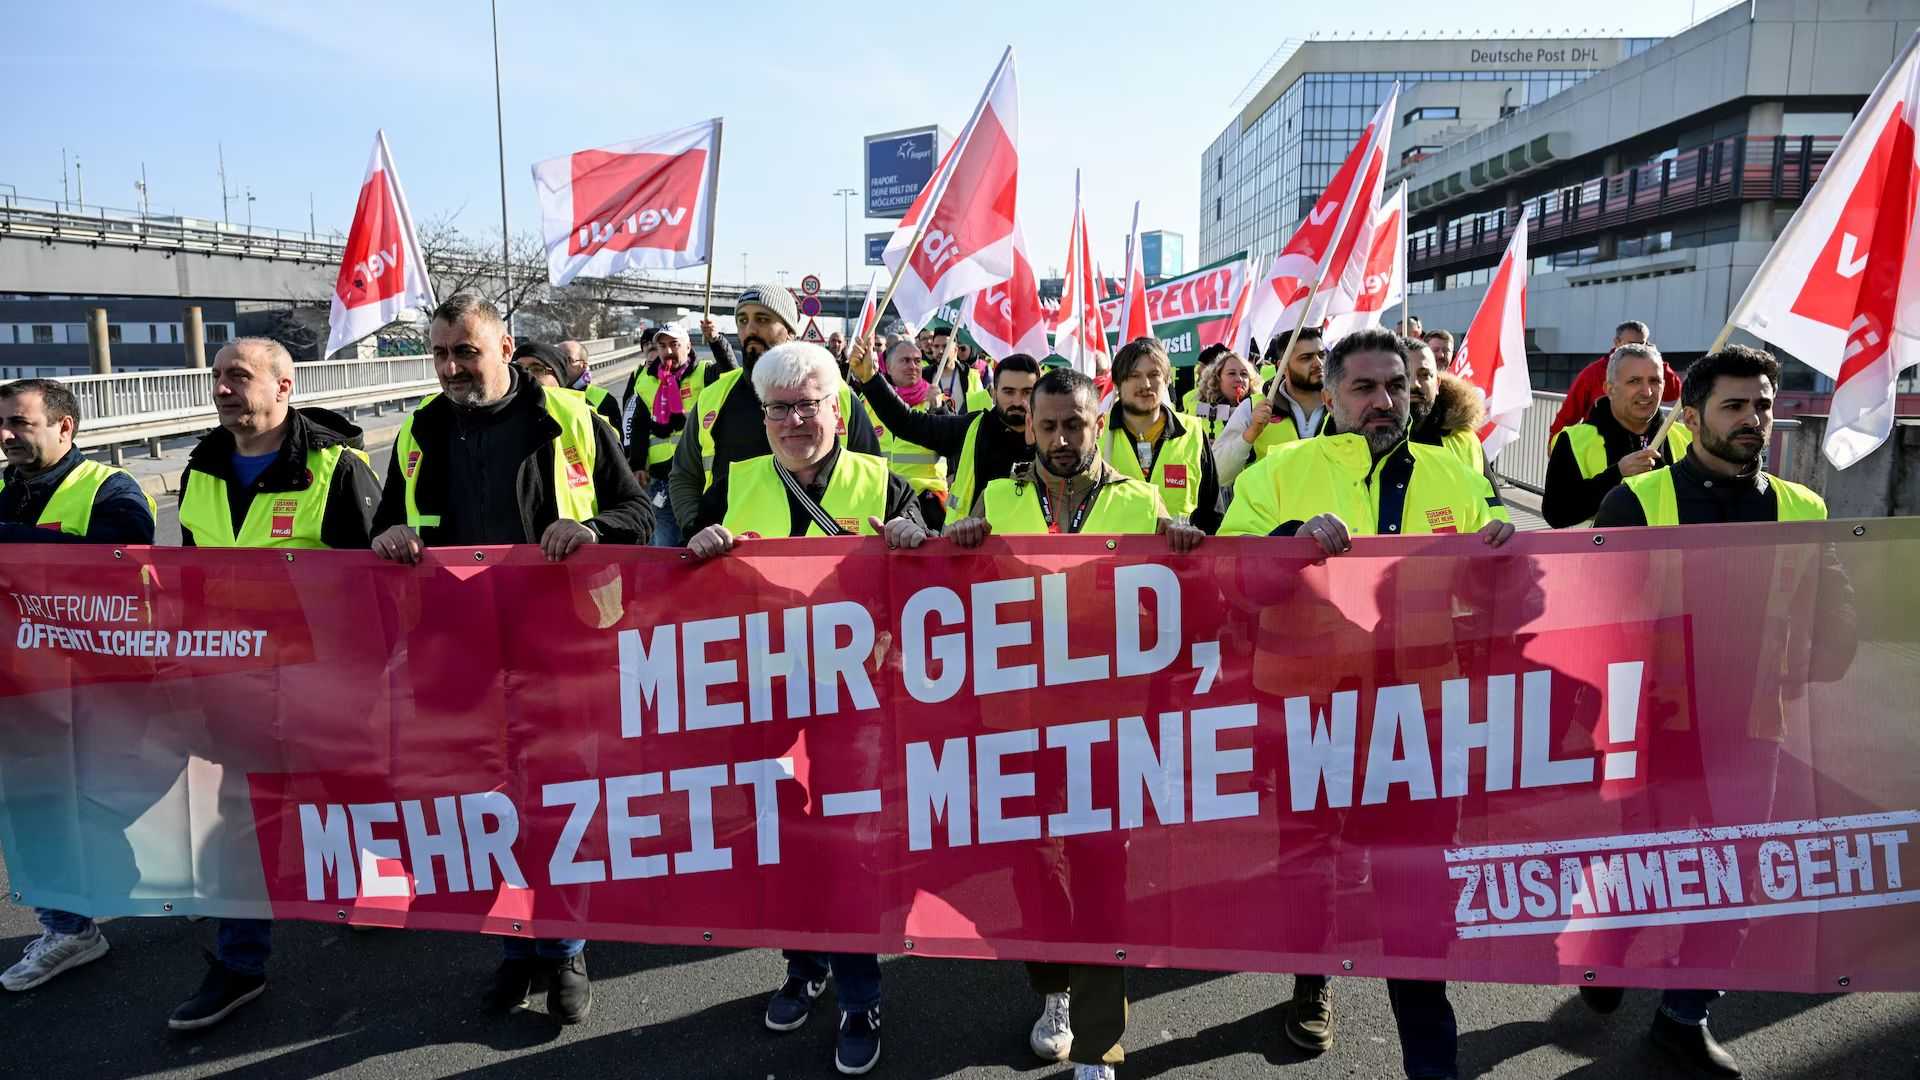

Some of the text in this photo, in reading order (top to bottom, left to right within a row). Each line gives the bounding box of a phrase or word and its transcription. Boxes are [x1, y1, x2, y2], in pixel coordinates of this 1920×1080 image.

[1471, 48, 1598, 63] Deutsche Post DHL
[806, 281, 816, 290] 50
[1166, 477, 1185, 486] ver.di
[10, 593, 139, 622] TARIFRUNDE
[16, 618, 268, 657] ÖFFENTLICHER DIENST
[618, 563, 1221, 739] MEHR GELD,
[299, 791, 528, 900] MEHR
[541, 757, 794, 886] ZEIT
[905, 702, 1260, 852] MEINE
[1448, 830, 1910, 923] ZUSAMMEN GEHT
